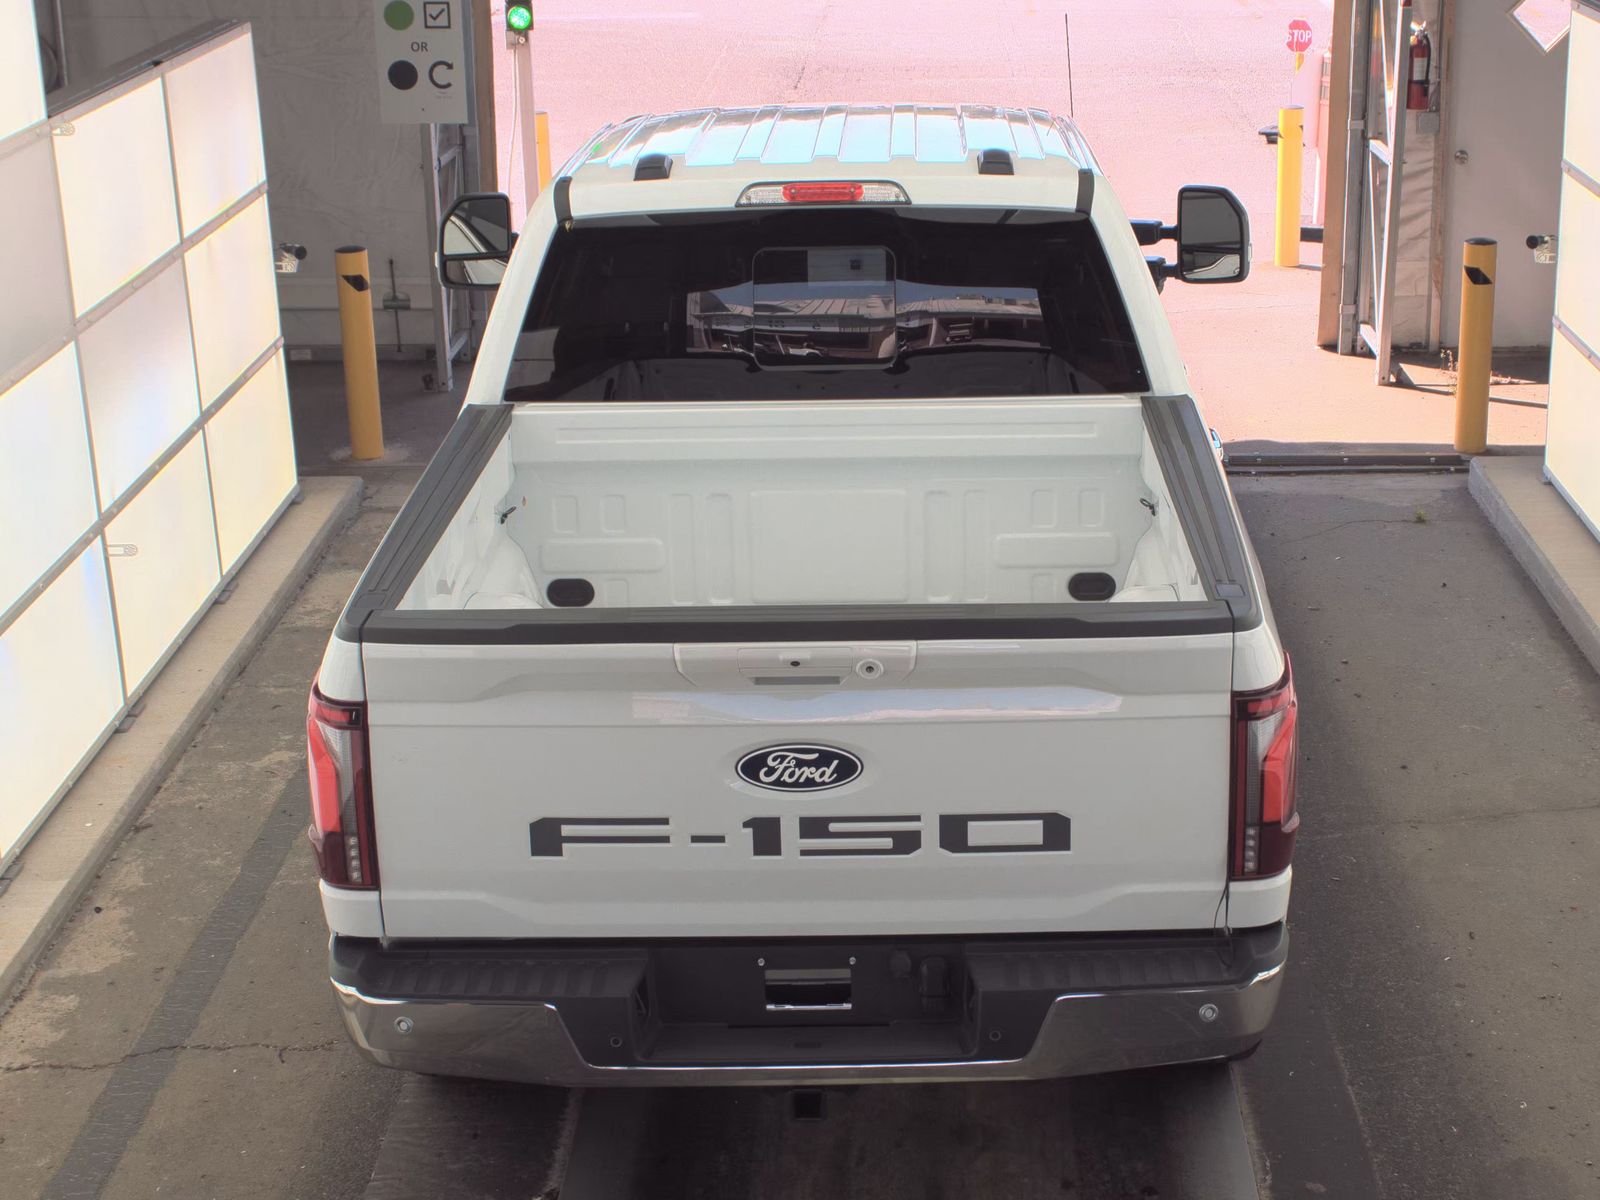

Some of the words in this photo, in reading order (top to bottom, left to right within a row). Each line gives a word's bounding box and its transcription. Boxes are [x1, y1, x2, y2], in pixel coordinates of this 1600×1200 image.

[411, 41, 429, 52] OR
[1286, 29, 1312, 43] STOP
[759, 751, 839, 783] Ford
[529, 812, 1072, 857] F-150
